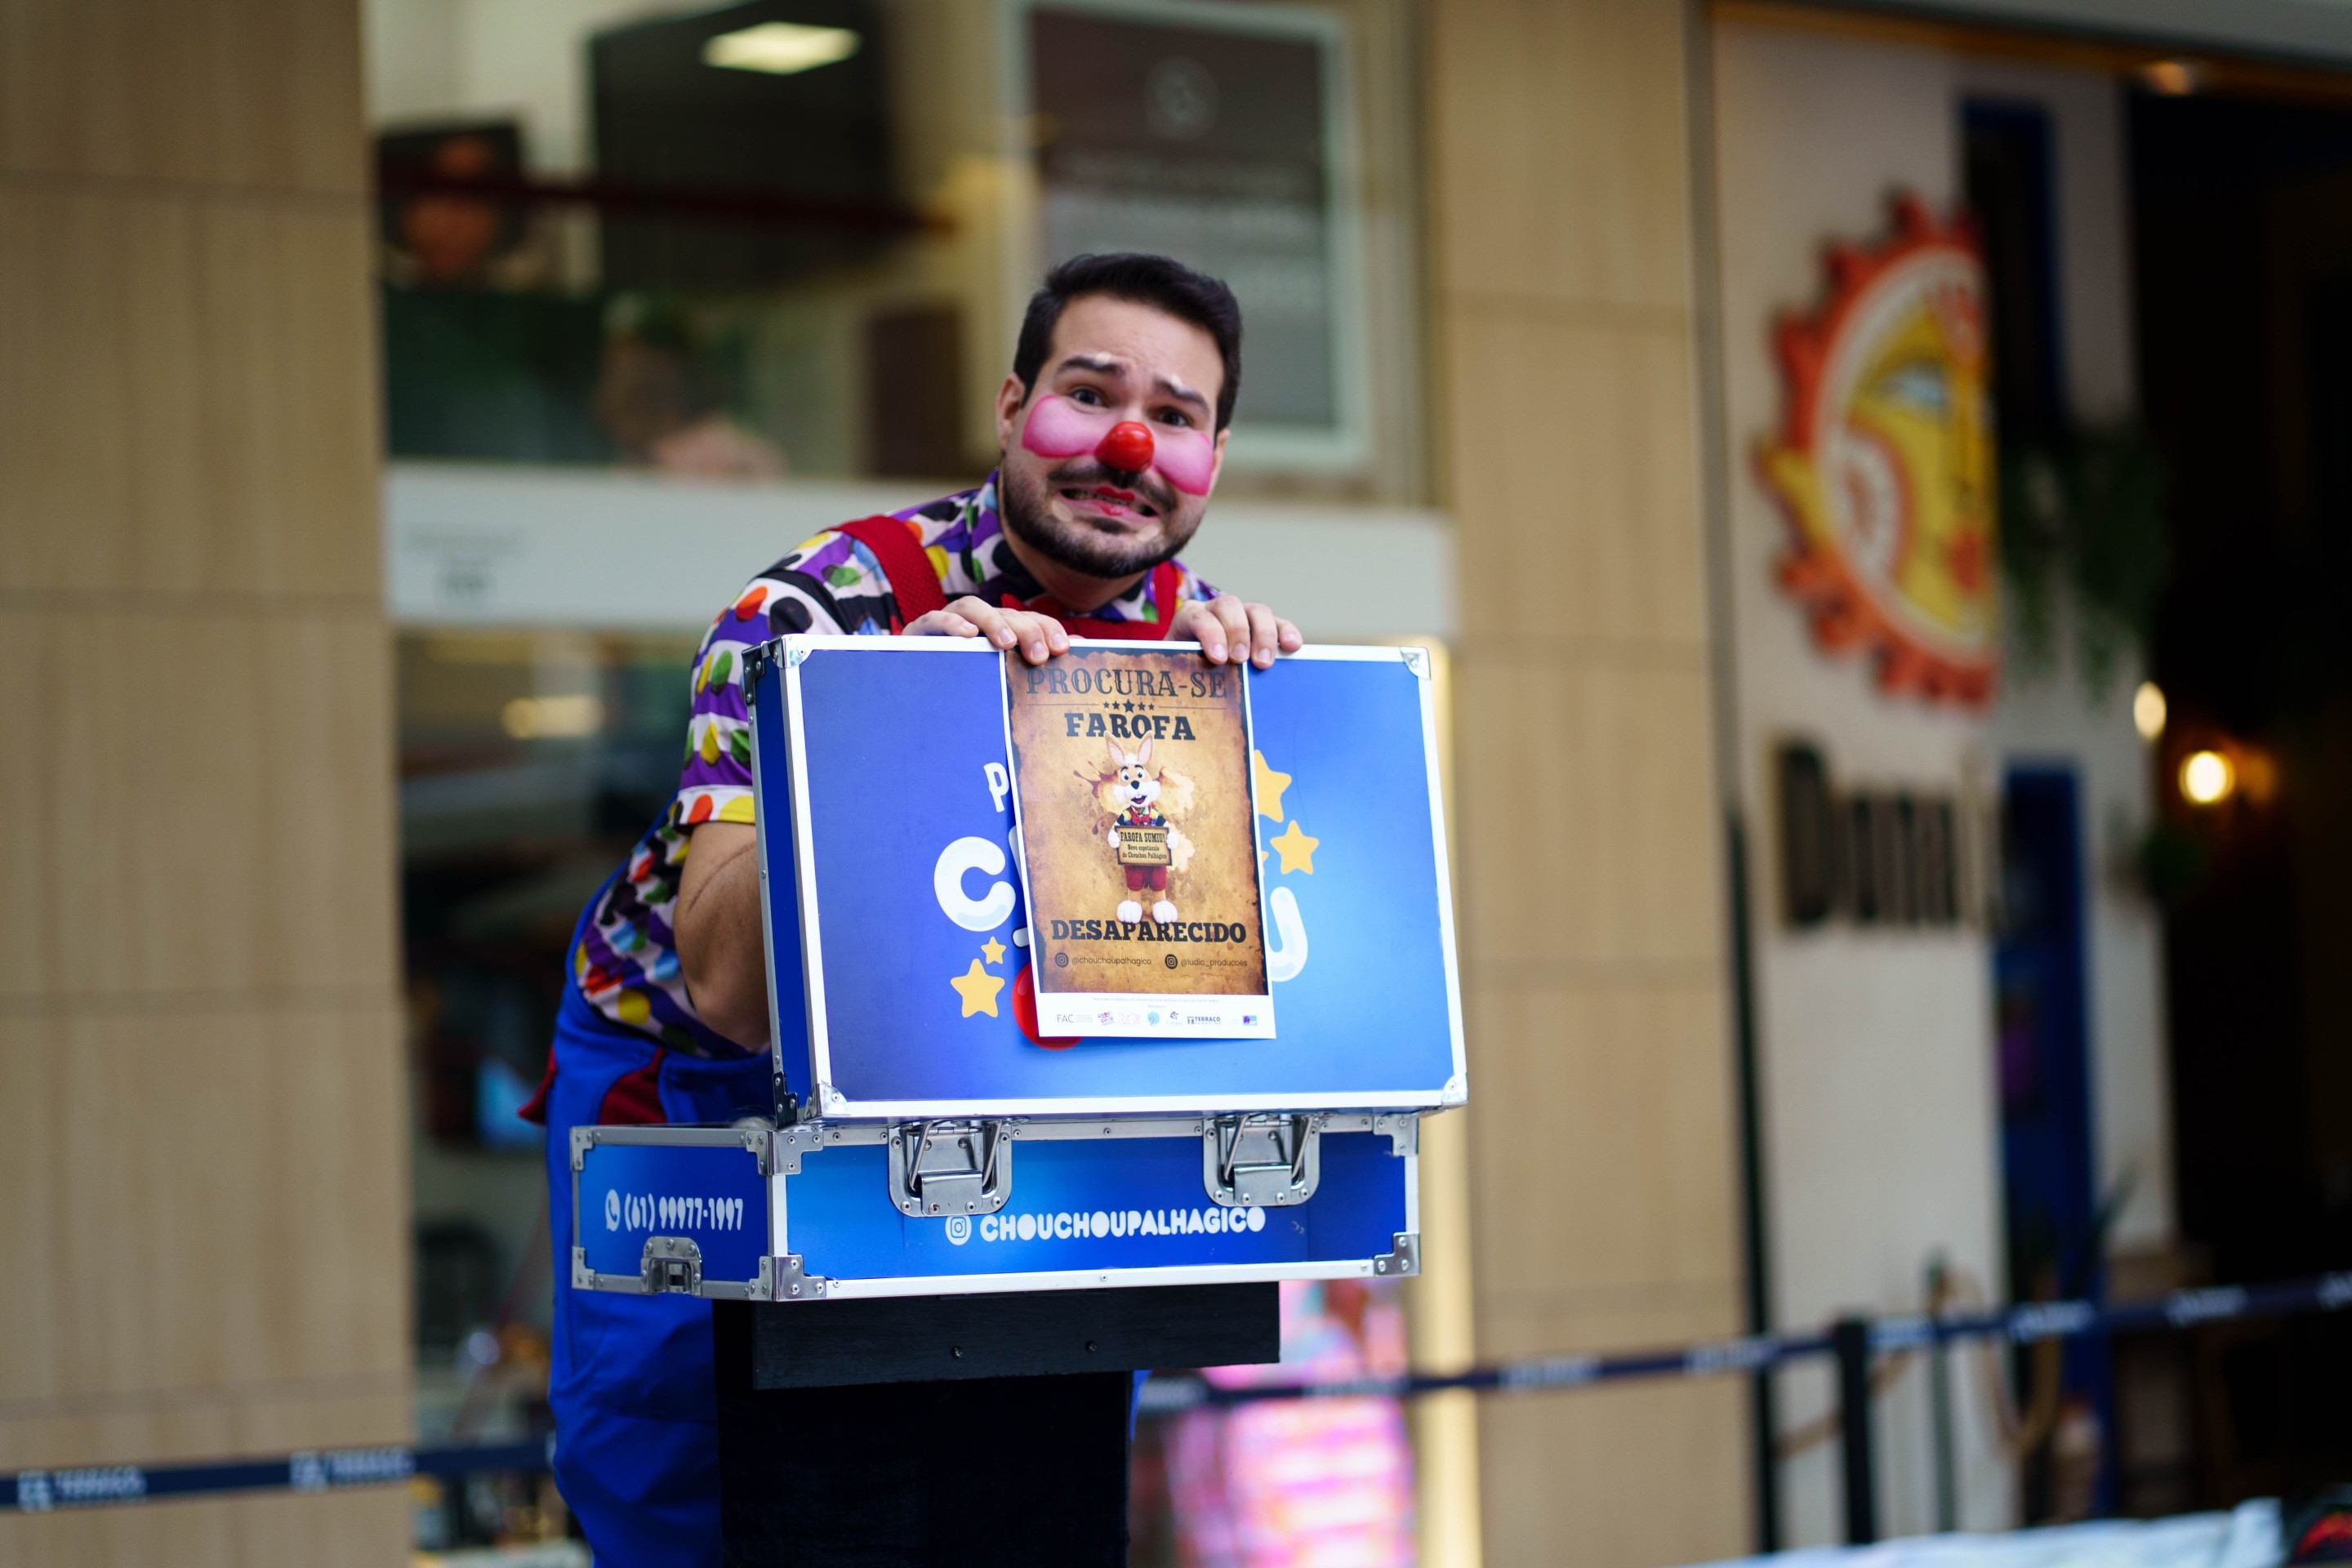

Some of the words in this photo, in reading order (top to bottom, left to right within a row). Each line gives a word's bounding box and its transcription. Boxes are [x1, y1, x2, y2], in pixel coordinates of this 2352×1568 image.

[1027, 667, 1227, 698] PROCURA-SE
[1064, 712, 1196, 741] FAROFA
[1120, 831, 1143, 842] FAROFA
[1144, 832, 1165, 843] SUMIU!
[1050, 920, 1246, 943] DESAPARECIDO
[1071, 956, 1152, 967] @chouchoupalhagico
[1057, 1013, 1075, 1023] FAC
[625, 1192, 656, 1232] (61)
[658, 1196, 744, 1232] 99977-1997
[980, 1206, 1266, 1242] CHOUCHOUPALHAGICO
